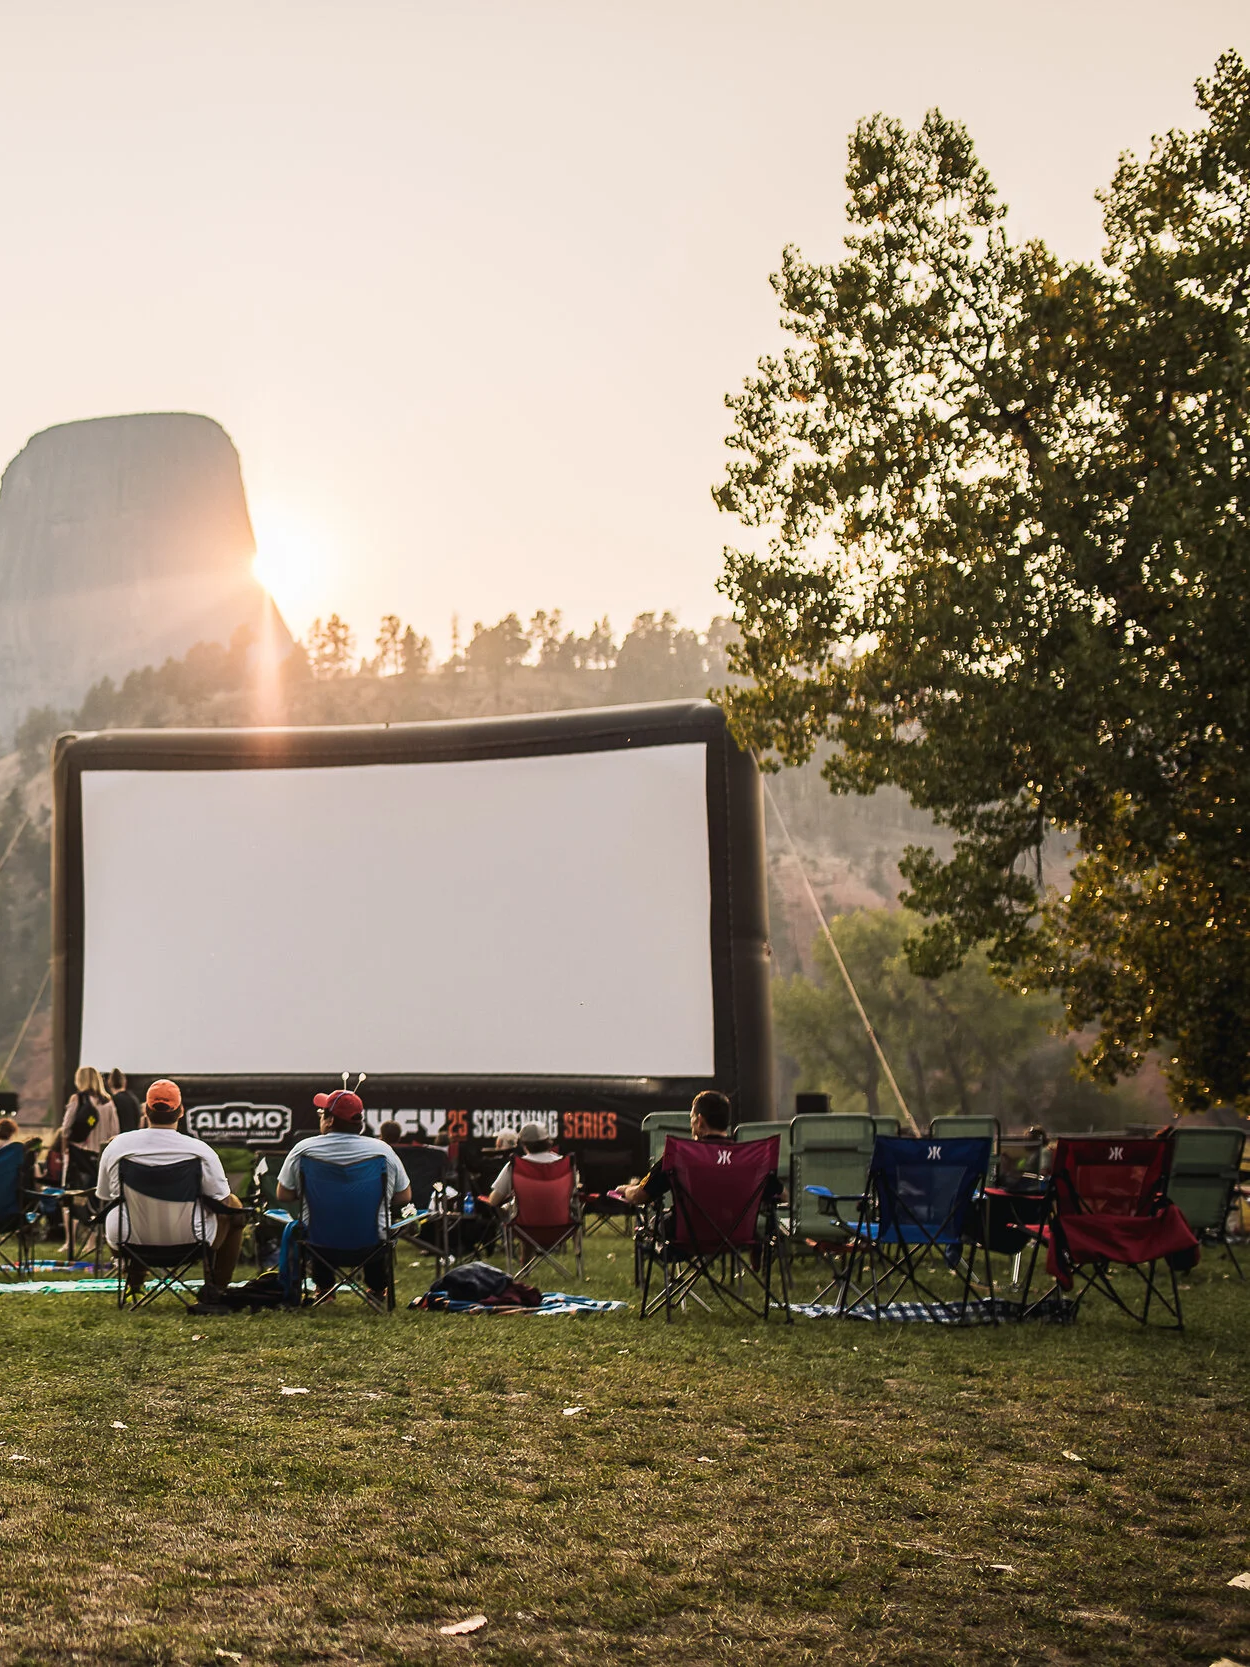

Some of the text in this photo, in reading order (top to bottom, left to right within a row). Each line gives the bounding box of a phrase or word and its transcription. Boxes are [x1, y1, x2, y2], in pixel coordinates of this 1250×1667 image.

[196, 1111, 282, 1129] ALAMO
[359, 1108, 447, 1137] YFY
[447, 1109, 468, 1137] 25
[563, 1110, 617, 1140] SERIES
